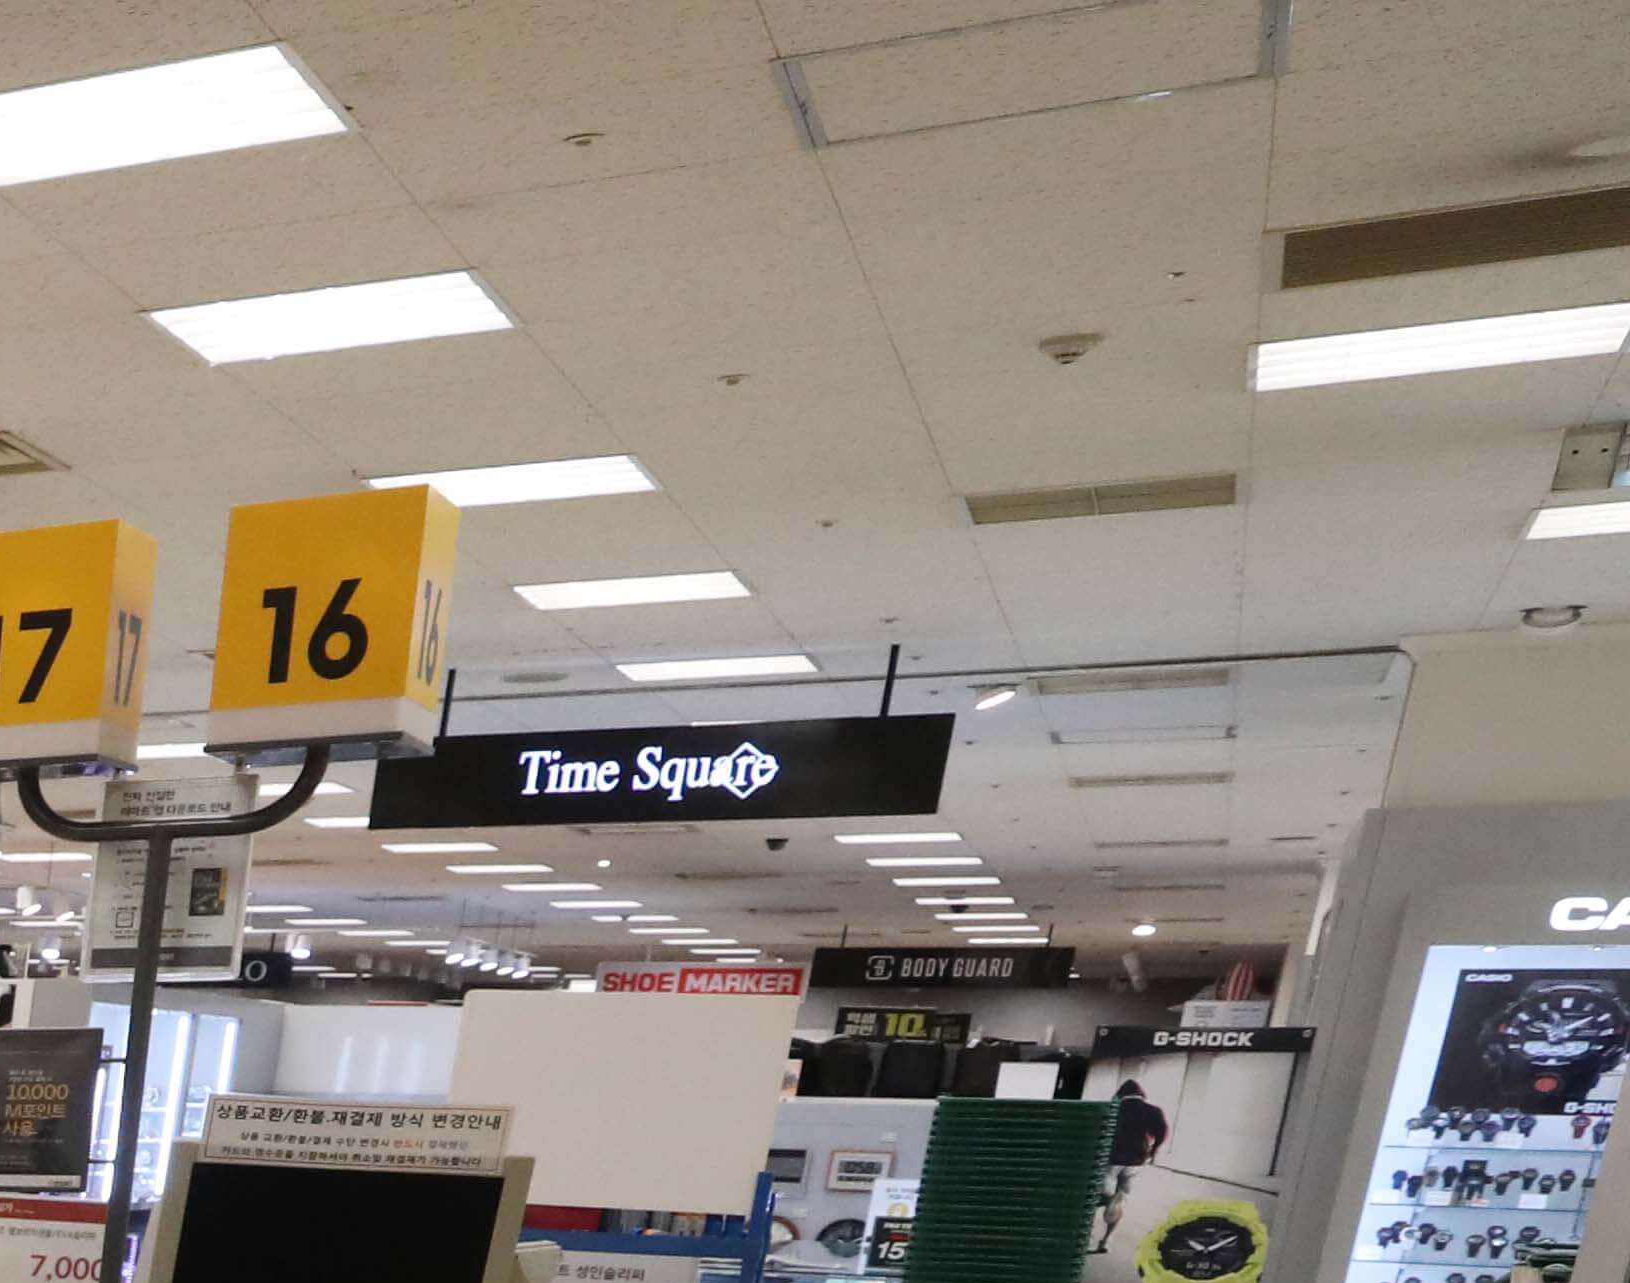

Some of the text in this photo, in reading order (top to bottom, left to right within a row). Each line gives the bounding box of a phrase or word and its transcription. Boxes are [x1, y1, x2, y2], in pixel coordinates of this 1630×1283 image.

[262, 577, 369, 685] 16
[416, 579, 443, 686] 16
[114, 610, 143, 708] 17
[518, 741, 780, 802] Time Square
[901, 957, 1013, 979] BODY GUARD
[1466, 973, 1513, 983] CASIO
[603, 971, 797, 994] SHOE MARKER
[1153, 1029, 1254, 1049] G-SHOCK
[391, 1112, 424, 1128] 방식
[432, 1112, 502, 1131] 변경안내
[575, 1264, 646, 1282] 성인슬리퍼
